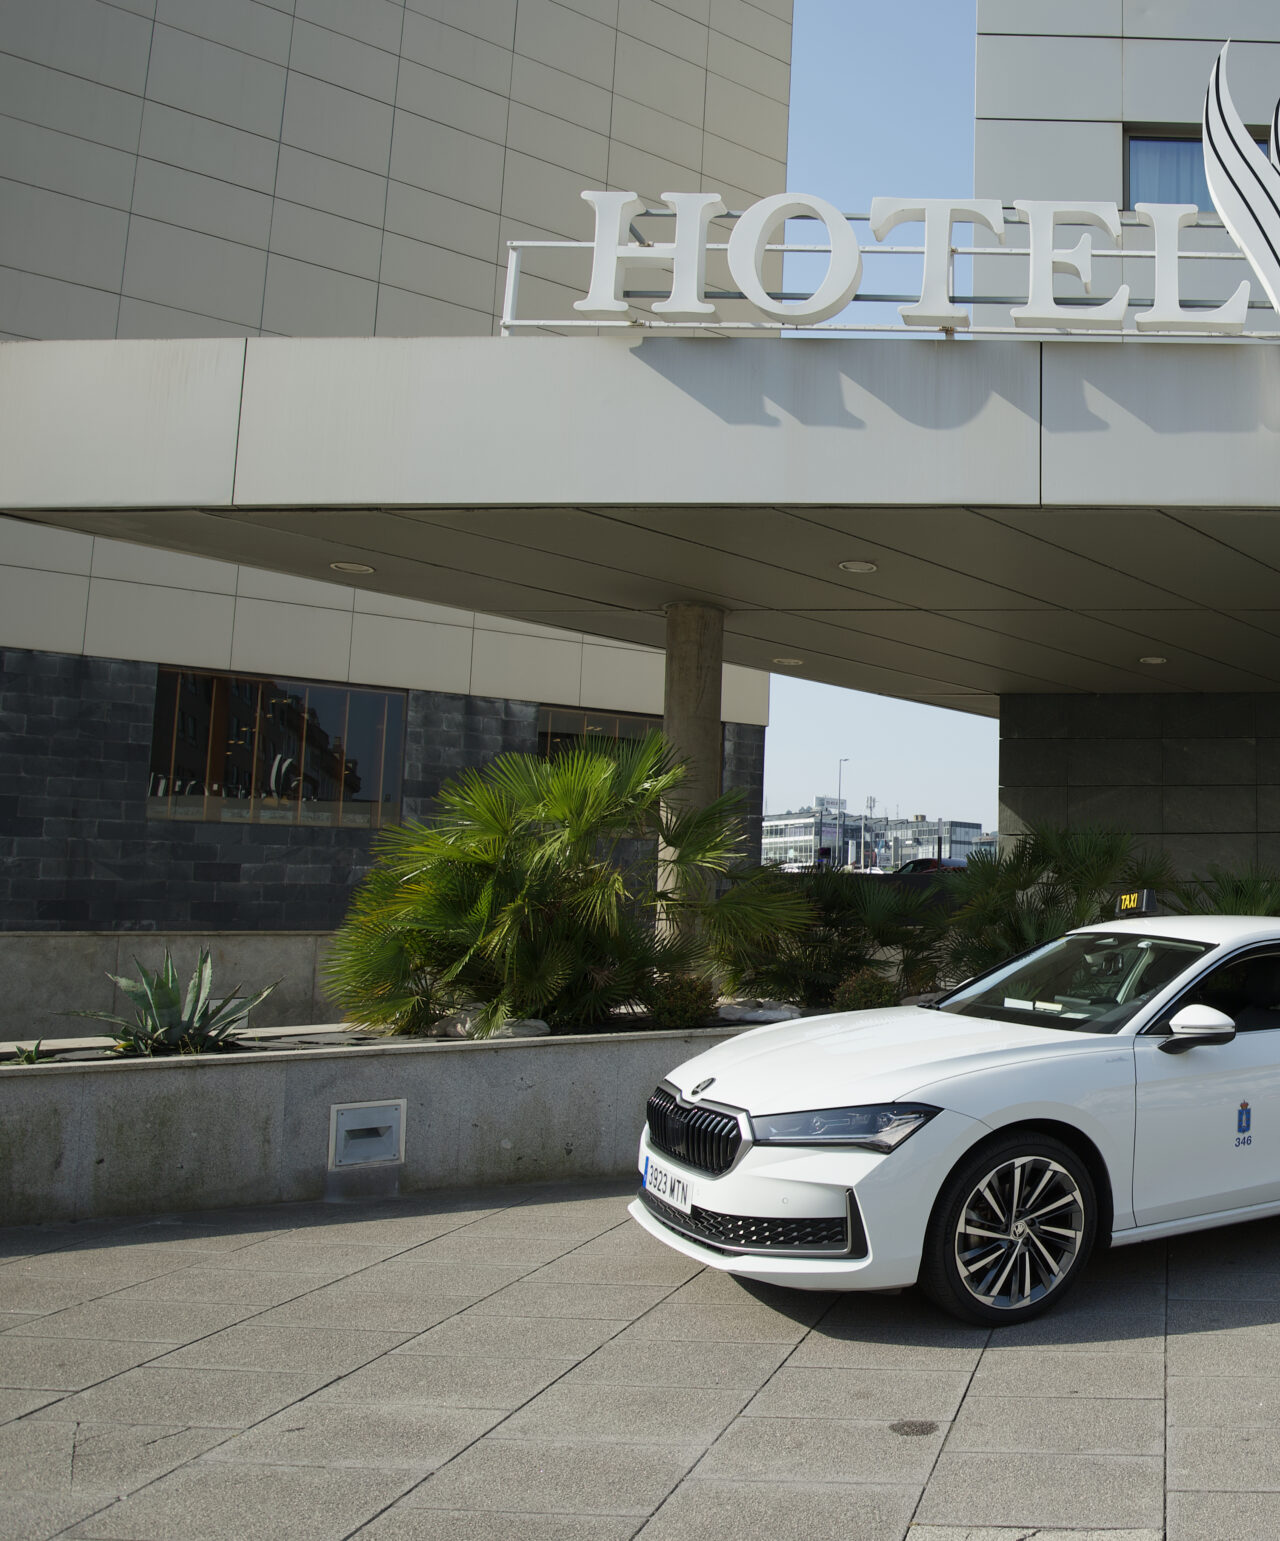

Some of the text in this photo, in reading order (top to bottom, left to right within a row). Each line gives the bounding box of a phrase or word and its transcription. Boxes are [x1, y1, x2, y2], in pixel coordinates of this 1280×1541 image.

[573, 190, 1251, 334] HOTEL
[1121, 893, 1138, 910] TAXI
[1235, 1135, 1252, 1147] 346
[648, 1165, 689, 1206] 3923 MTN
